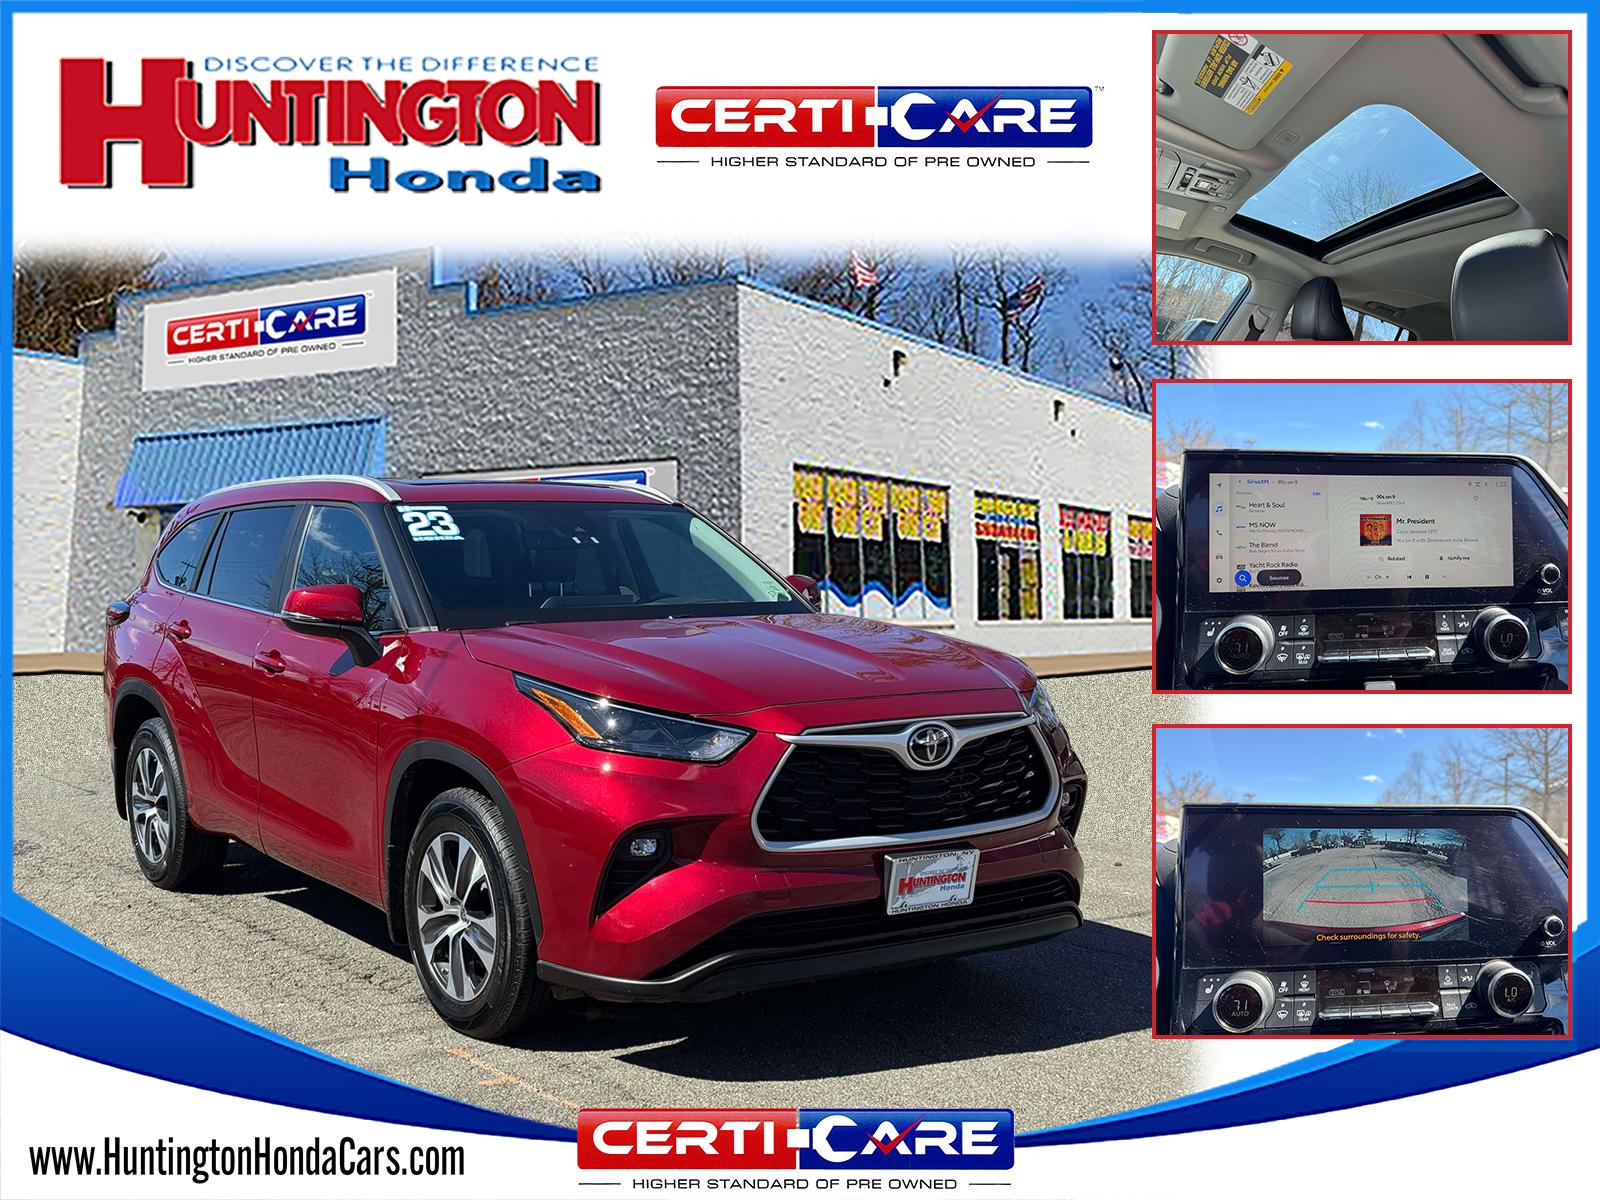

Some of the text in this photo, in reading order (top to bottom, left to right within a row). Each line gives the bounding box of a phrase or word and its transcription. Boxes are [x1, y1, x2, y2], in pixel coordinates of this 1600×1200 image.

[188, 342, 337, 364] HIGHER STANDARD OF PRE OWNED
[402, 511, 461, 537] 23
[1407, 517, 1436, 525] President
[898, 872, 967, 896] HUNTINGTON
[939, 883, 965, 892] Honda
[891, 900, 968, 915] HUNTINGTON HONDA
[1316, 931, 1421, 942] Check surroundings for safety.
